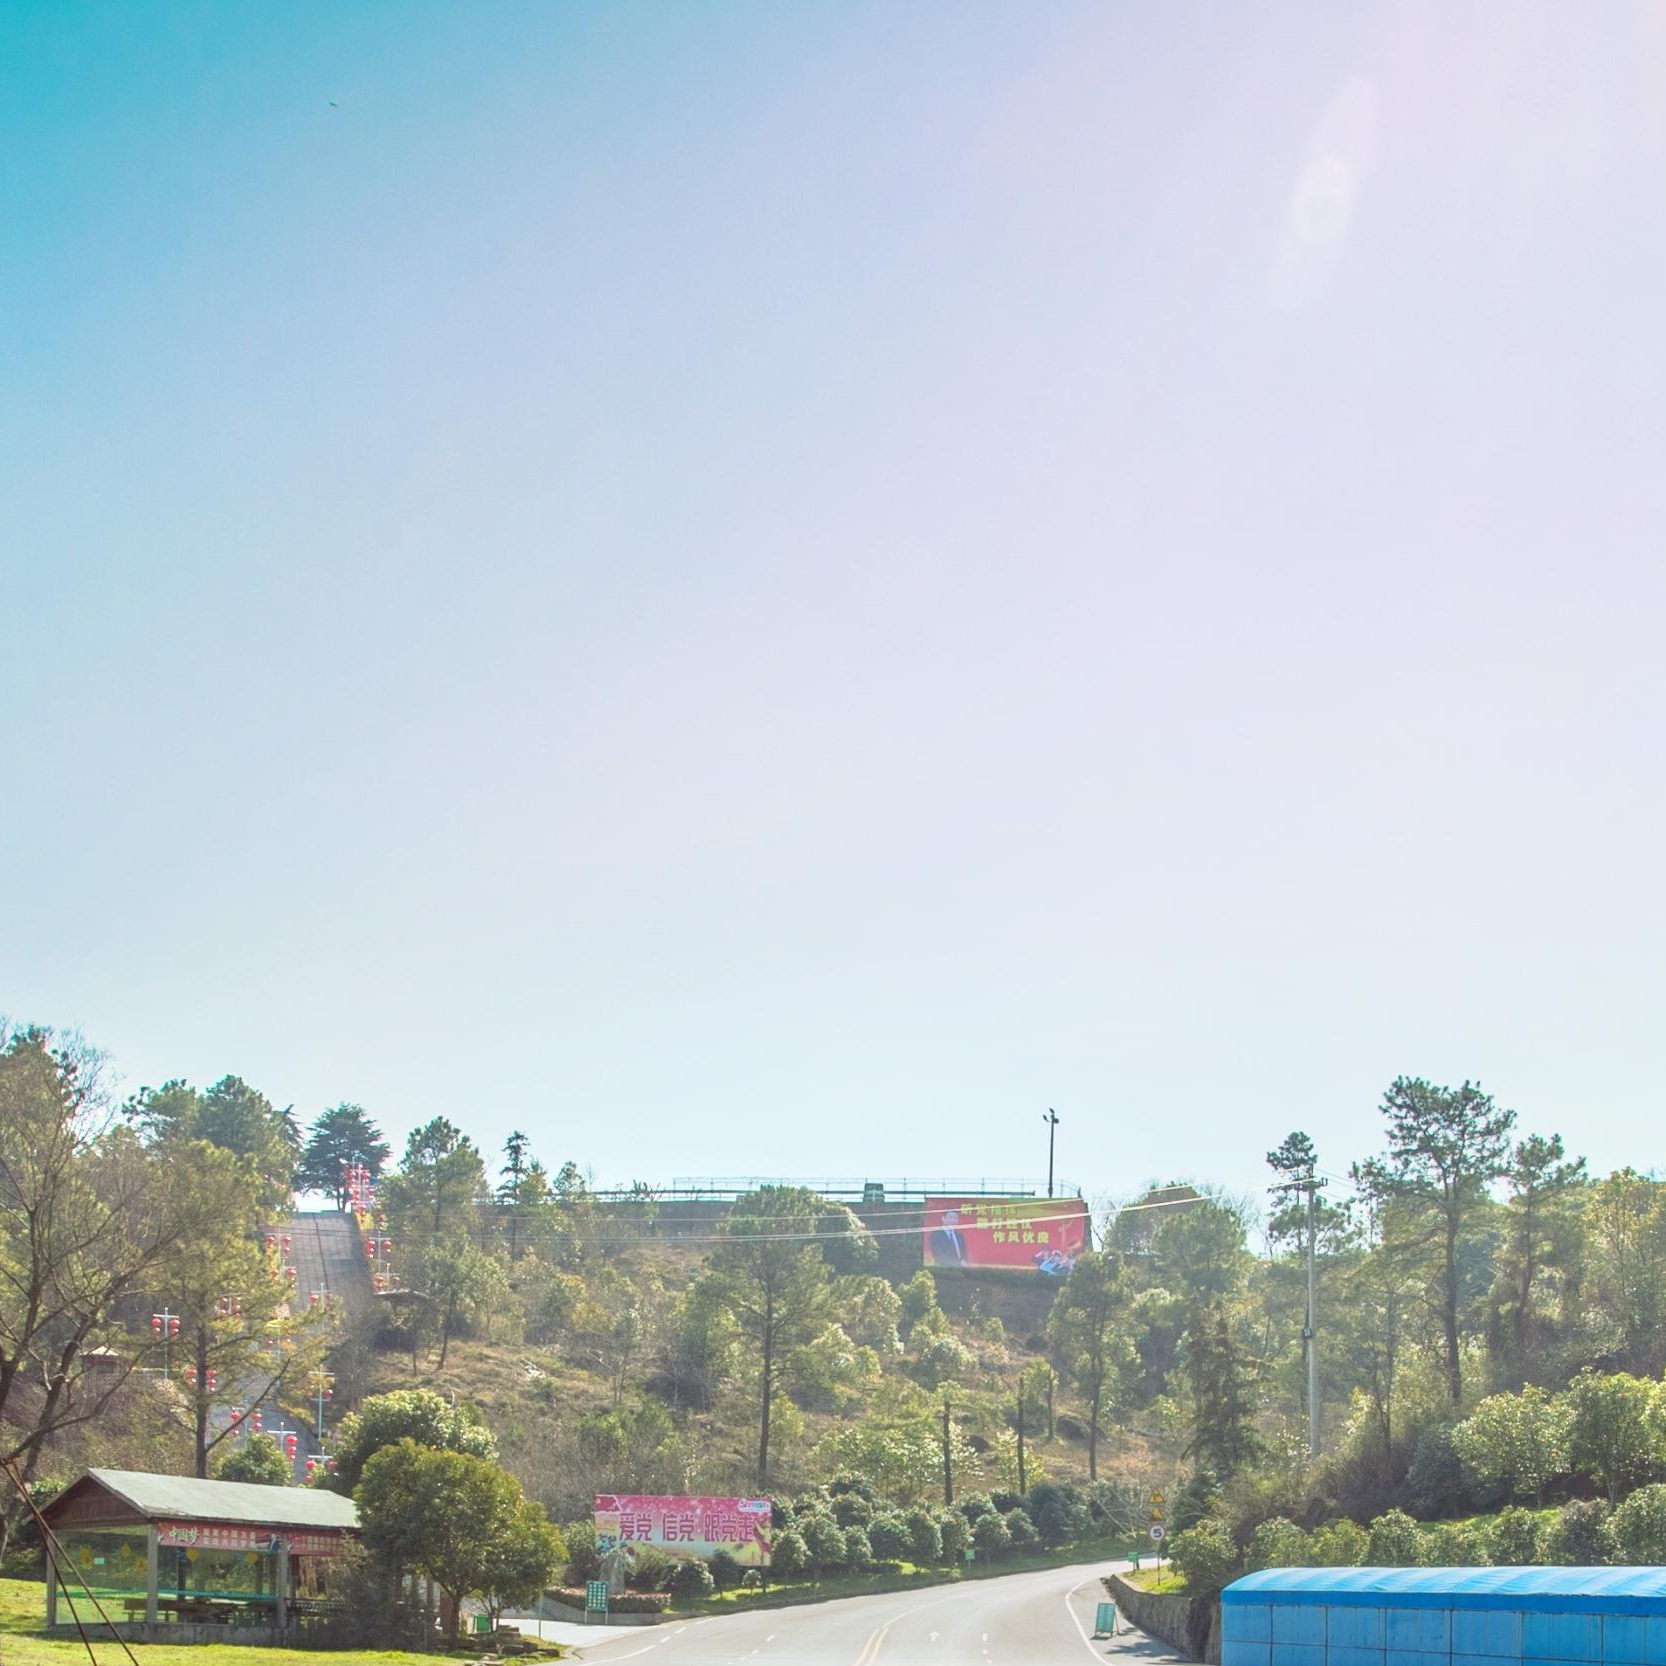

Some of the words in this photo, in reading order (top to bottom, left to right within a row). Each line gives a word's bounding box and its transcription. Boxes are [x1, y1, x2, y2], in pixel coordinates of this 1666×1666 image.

[619, 1513, 652, 1542] 爱党
[662, 1513, 694, 1542] 信党
[704, 1514, 753, 1543] 跟党走
[1153, 1528, 1162, 1538] 5
